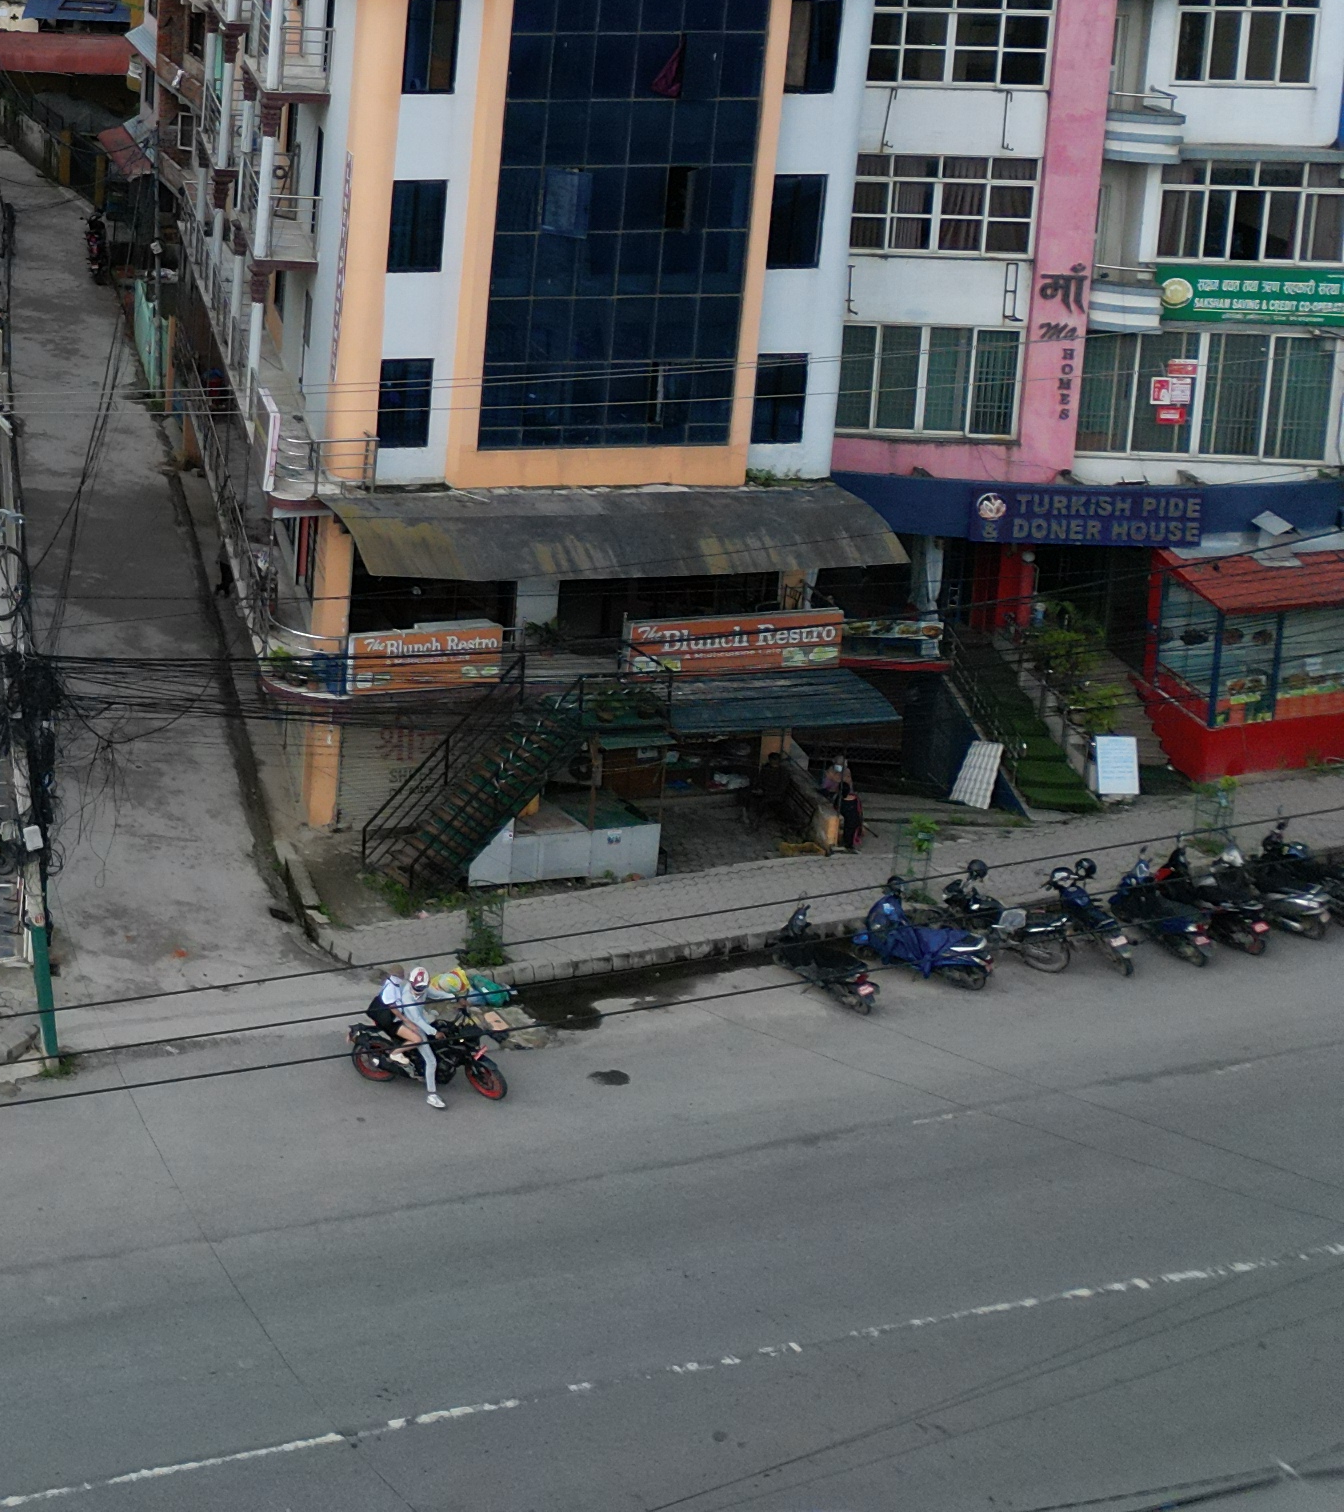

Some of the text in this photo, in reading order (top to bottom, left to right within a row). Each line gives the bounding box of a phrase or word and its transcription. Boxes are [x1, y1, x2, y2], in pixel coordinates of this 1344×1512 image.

[1268, 299, 1298, 312] CREDIT
[1057, 348, 1076, 420] HOMES
[1141, 497, 1202, 519] PIDE
[982, 519, 1201, 542] & DONER HOUSE
[364, 638, 386, 652] The
[447, 636, 498, 651] Restro
[638, 626, 662, 641] The
[756, 624, 837, 646] Restro
